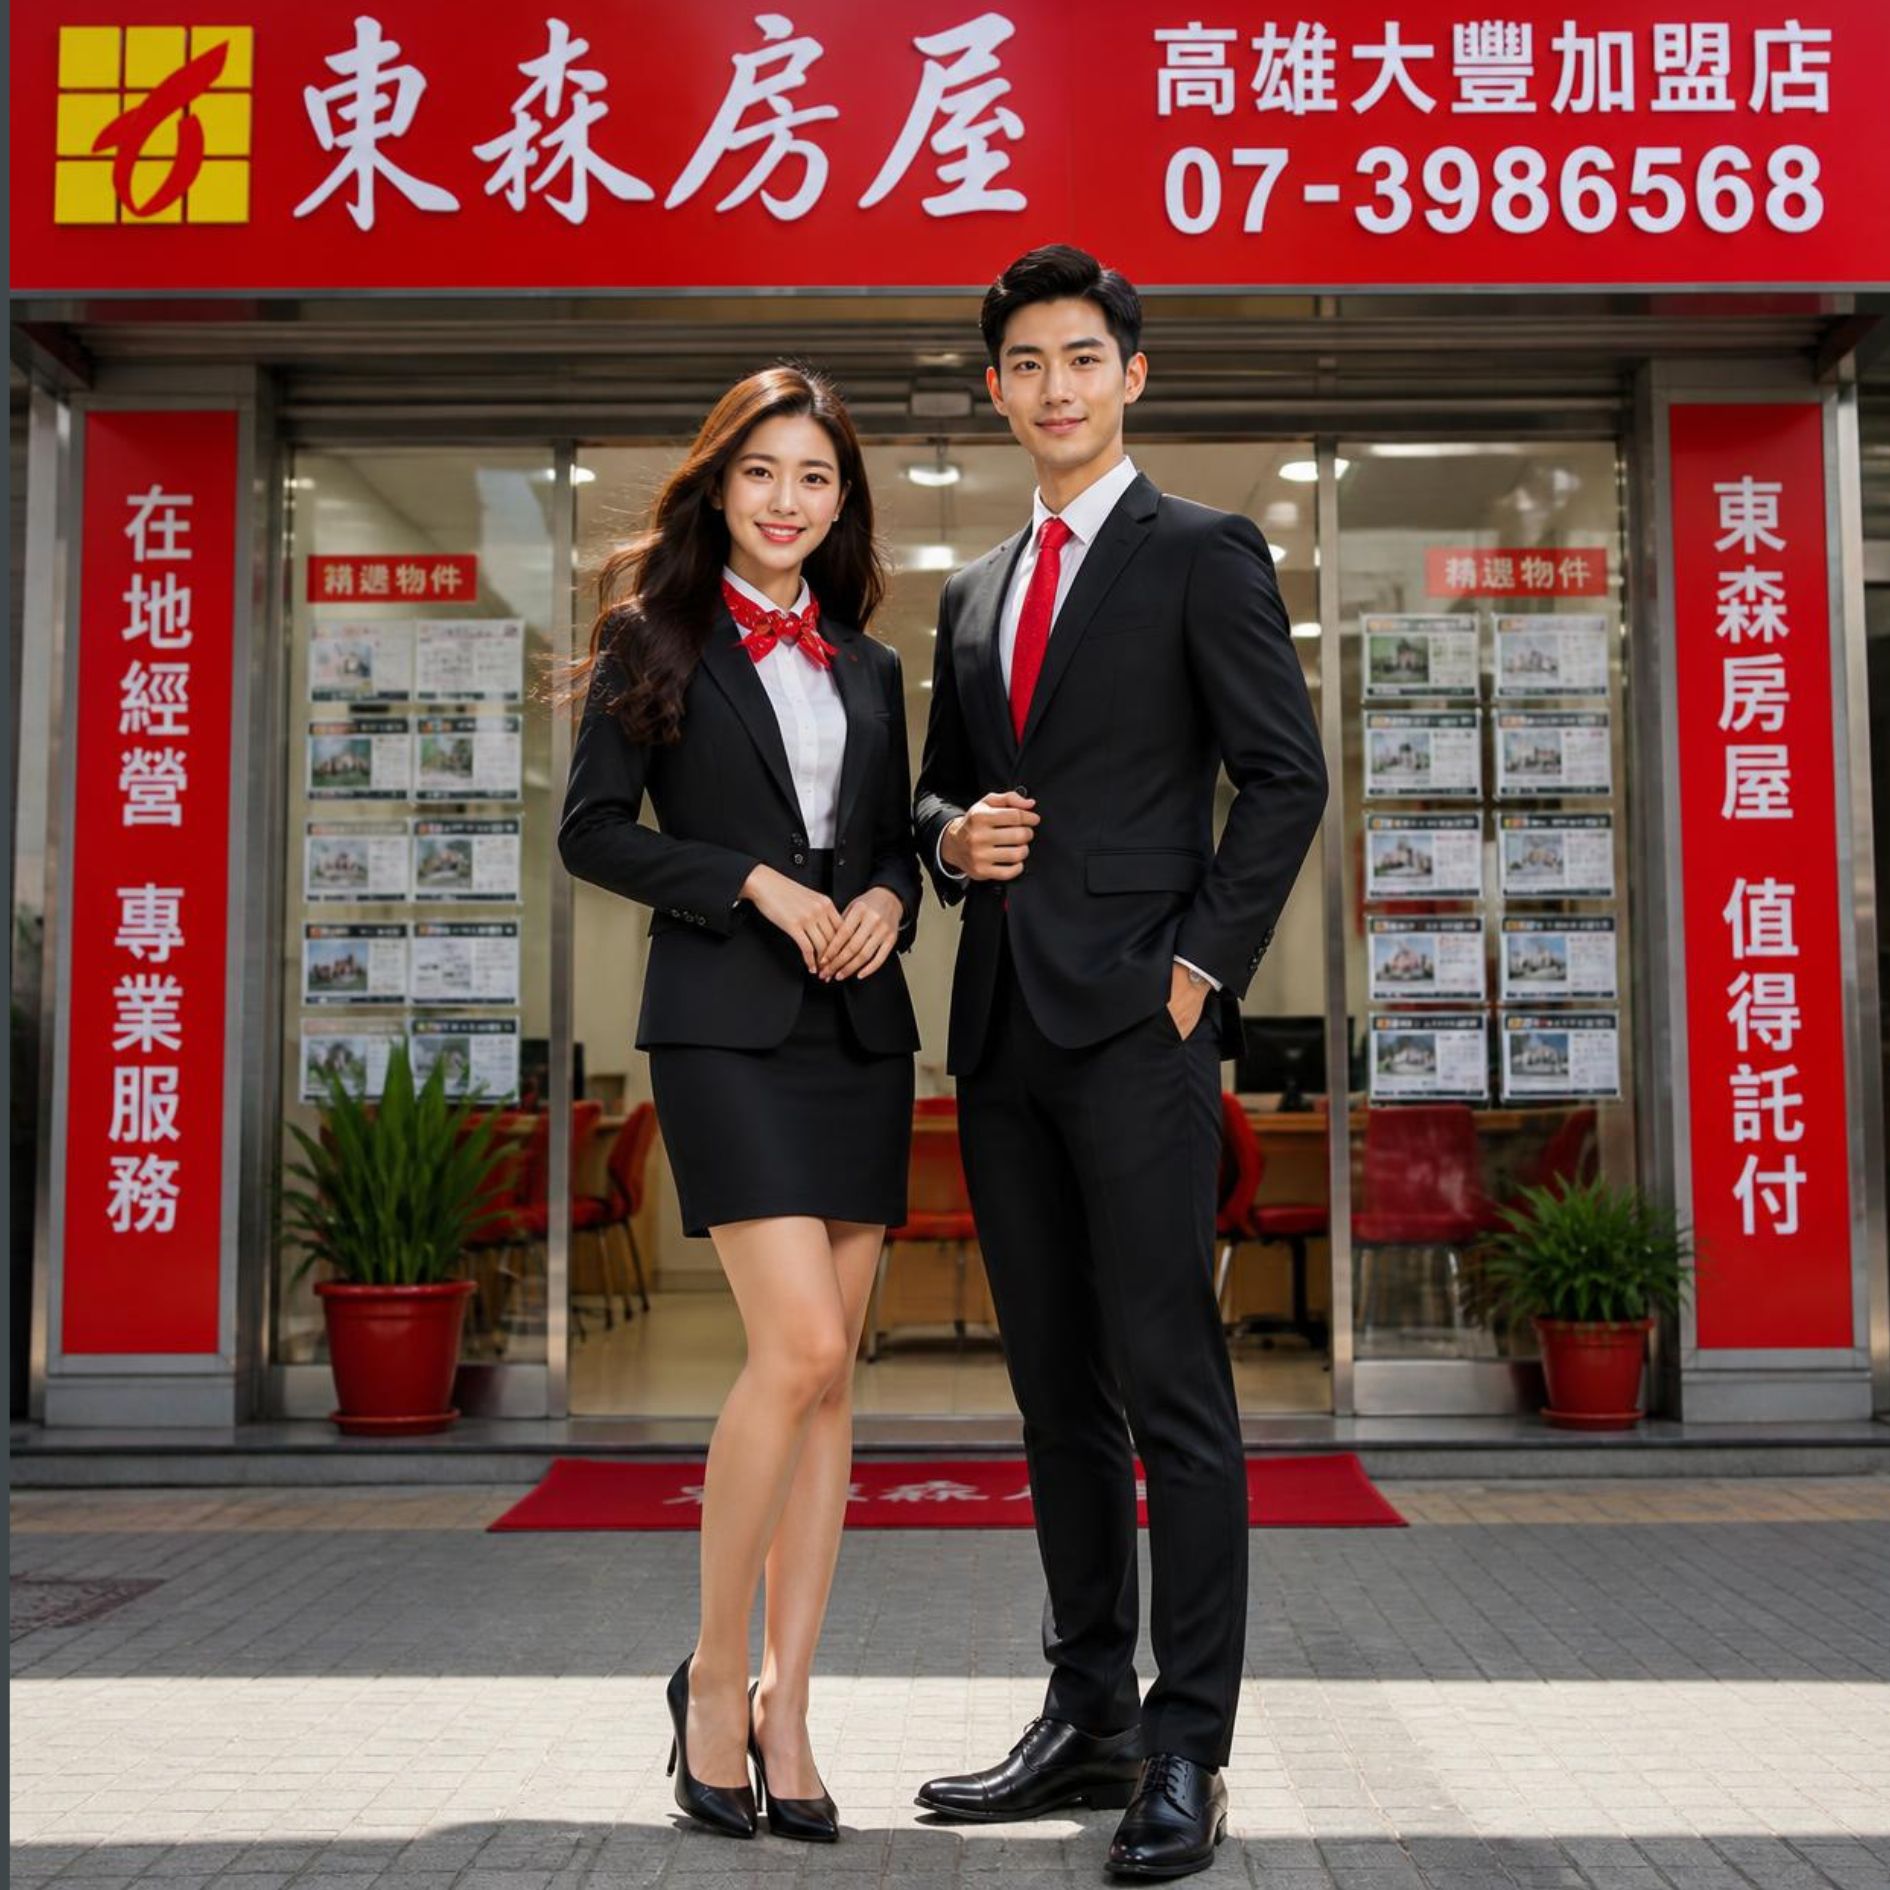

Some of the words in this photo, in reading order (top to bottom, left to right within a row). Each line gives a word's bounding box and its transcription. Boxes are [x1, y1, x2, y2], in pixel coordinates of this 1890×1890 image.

[293, 12, 1028, 231] 東森房屋
[1154, 19, 1833, 115] 高雄大豐加盟店
[1164, 144, 1826, 234] 07-3986568
[118, 485, 193, 827] 在地經營
[1713, 475, 1792, 821] 東森房屋
[106, 882, 185, 1233] 專業服務
[1722, 877, 1807, 1237] 值得託付
